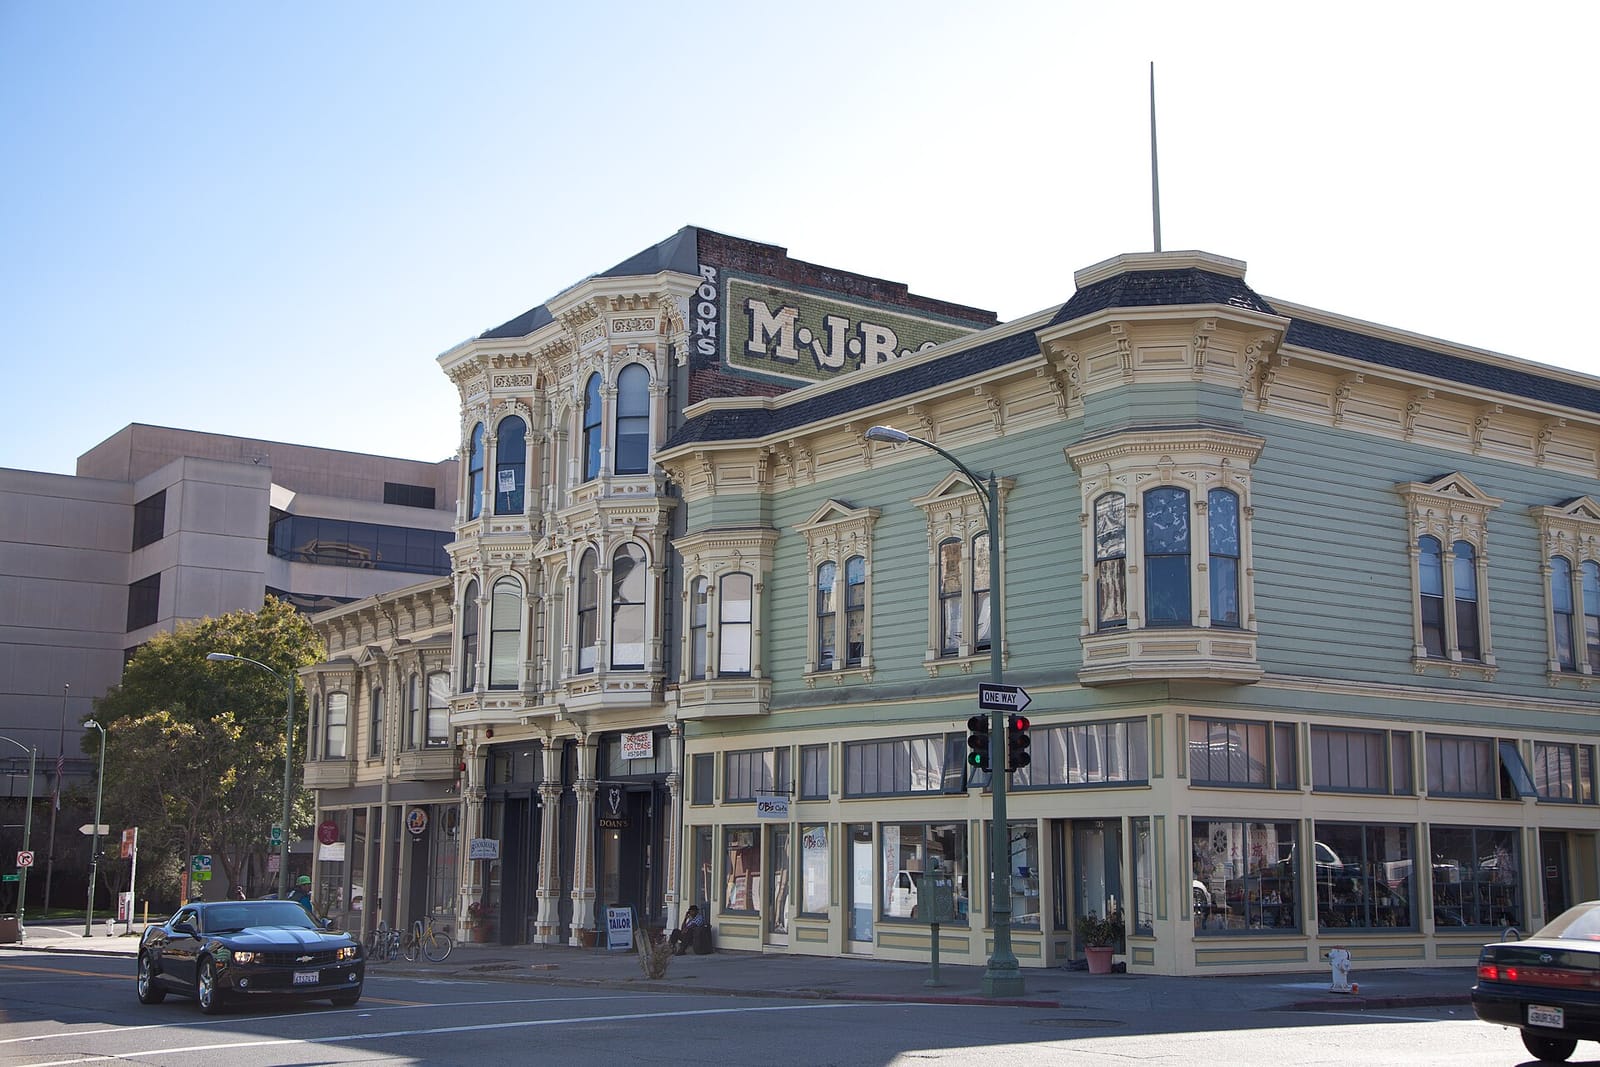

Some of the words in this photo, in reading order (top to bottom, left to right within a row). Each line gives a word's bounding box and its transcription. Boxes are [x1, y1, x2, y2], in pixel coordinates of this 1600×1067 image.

[697, 264, 717, 355] ROOMS
[984, 691, 1000, 703] ONE
[1001, 693, 1017, 704] WAY
[623, 743, 634, 752] FOR
[634, 741, 652, 751] LEASE
[609, 918, 631, 930] TAILOR
